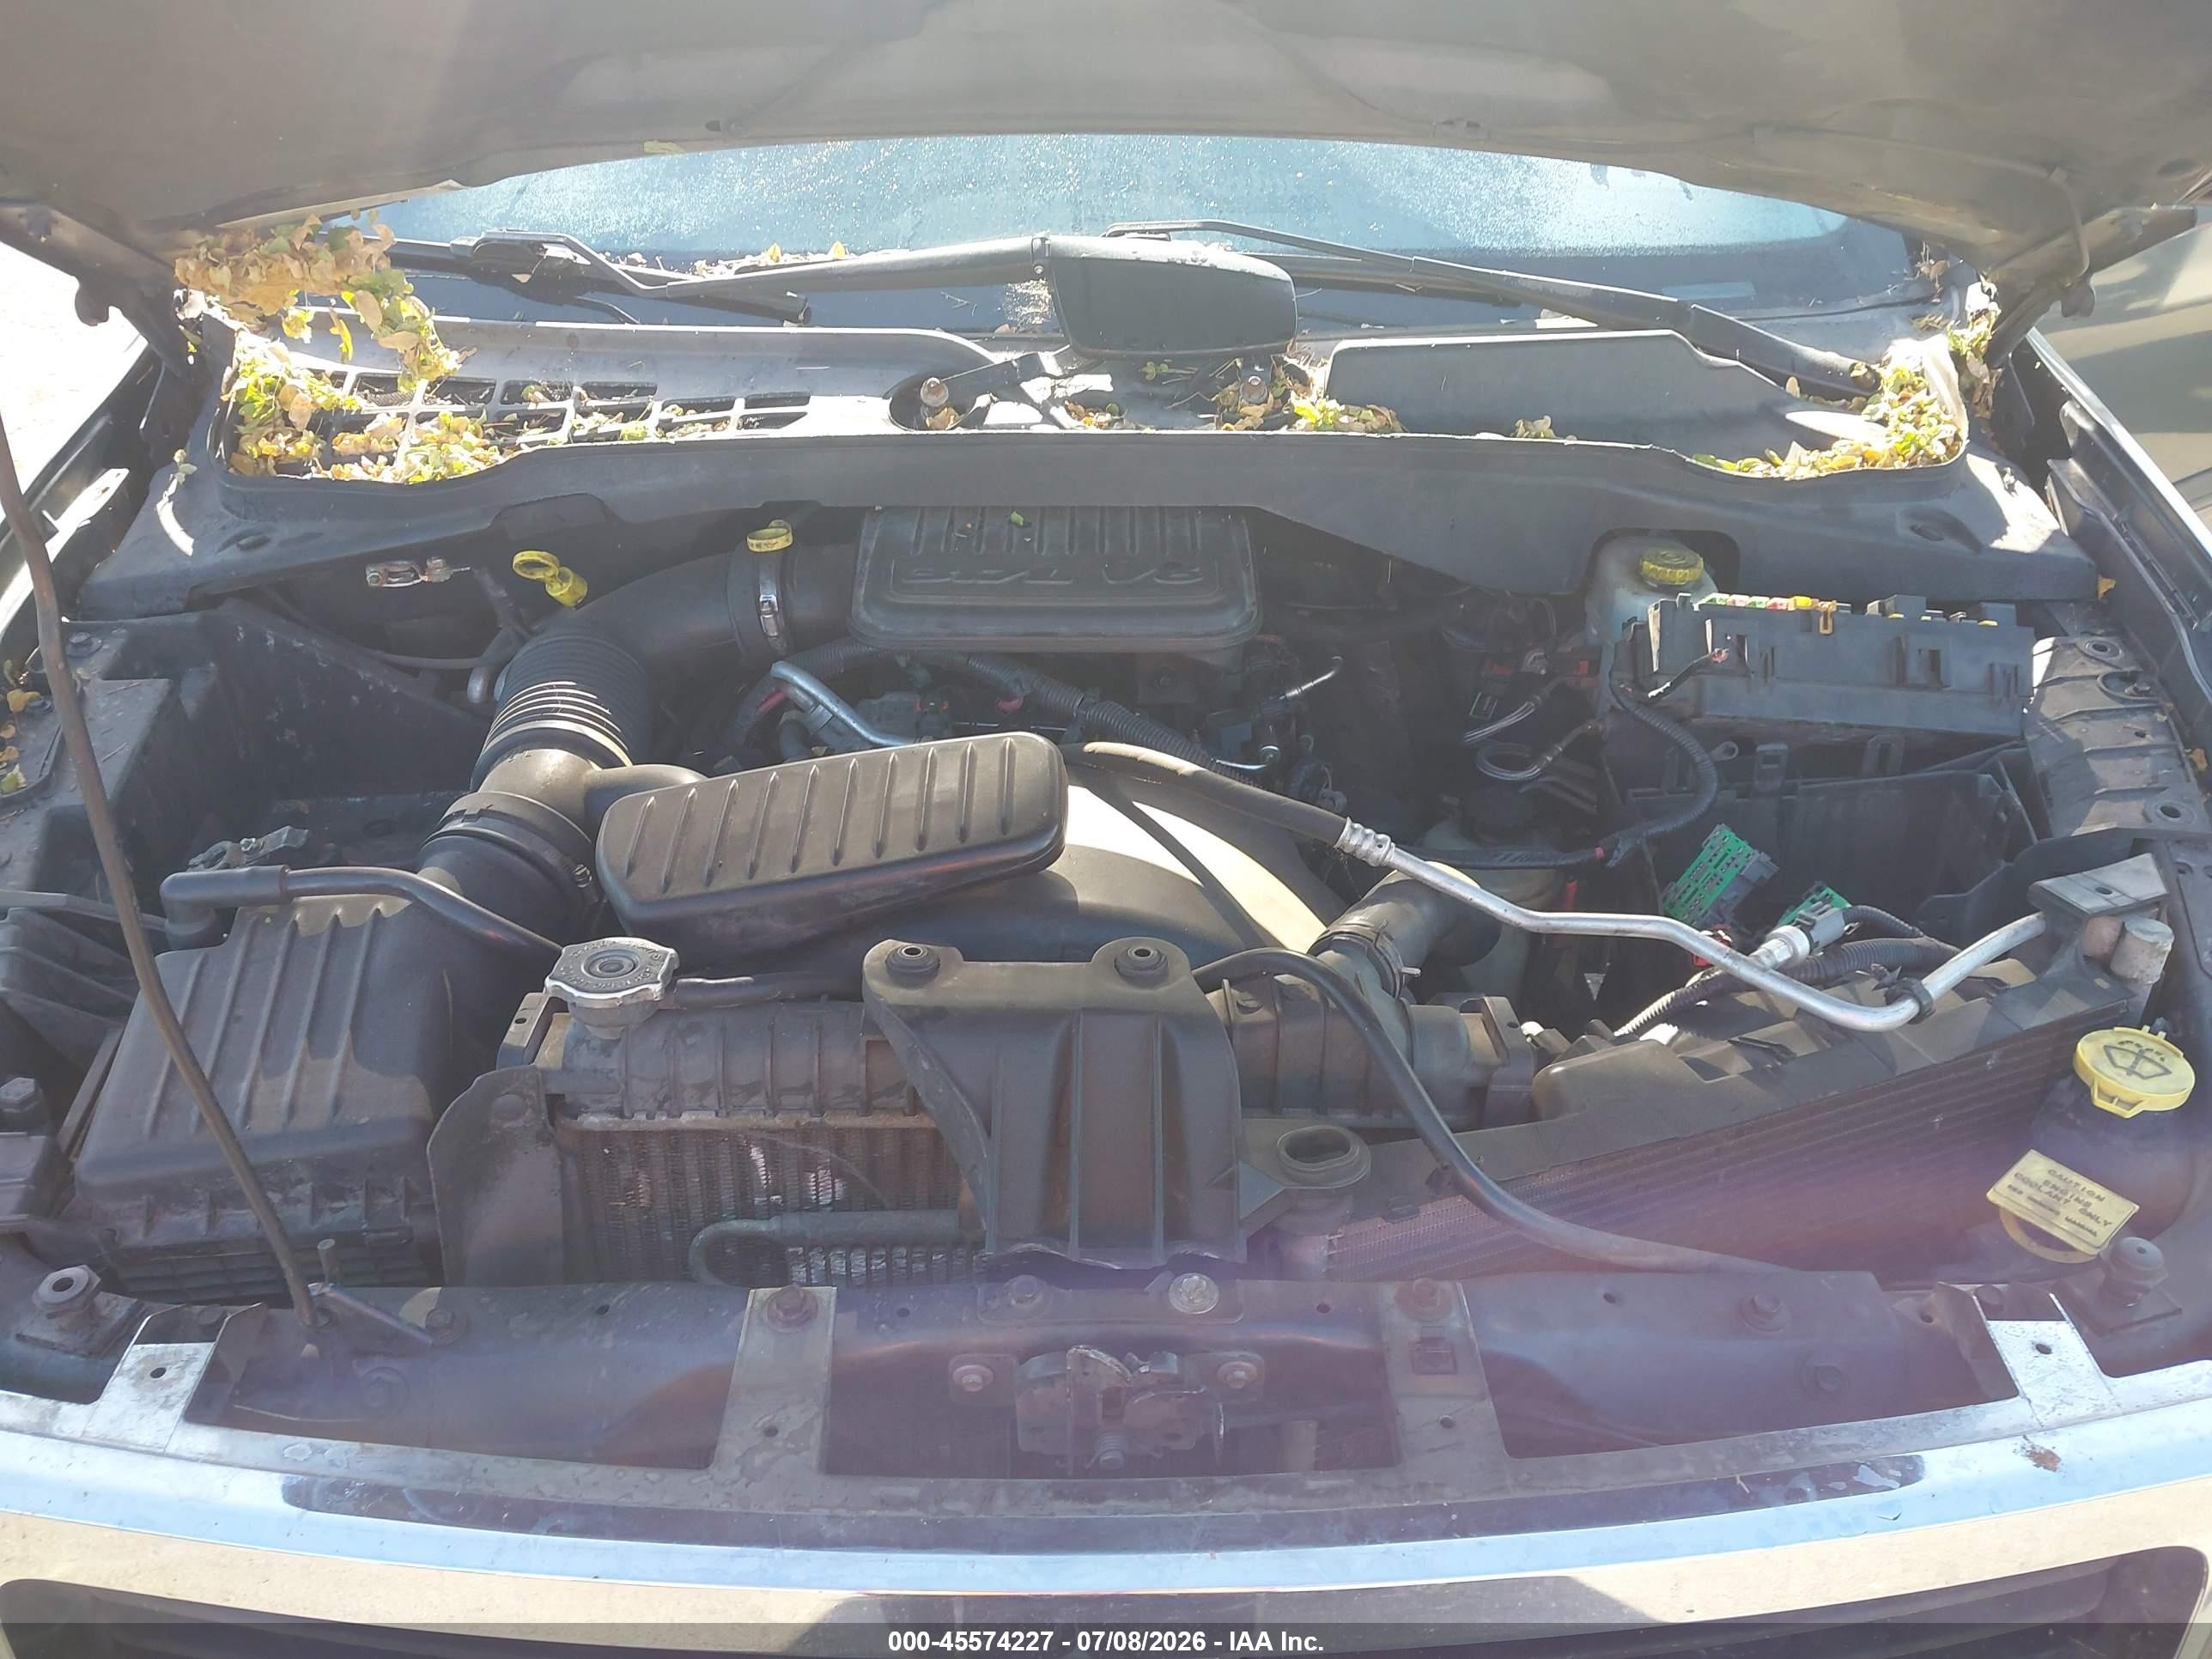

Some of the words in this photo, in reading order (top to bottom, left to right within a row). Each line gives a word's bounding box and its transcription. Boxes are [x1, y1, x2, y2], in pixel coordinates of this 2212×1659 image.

[2014, 1172, 2071, 1205] COOLANT
[2078, 1207, 2112, 1226] ONLY
[2042, 1179, 2093, 1208] ENGINE
[2047, 1169, 2106, 1202] CAUTION
